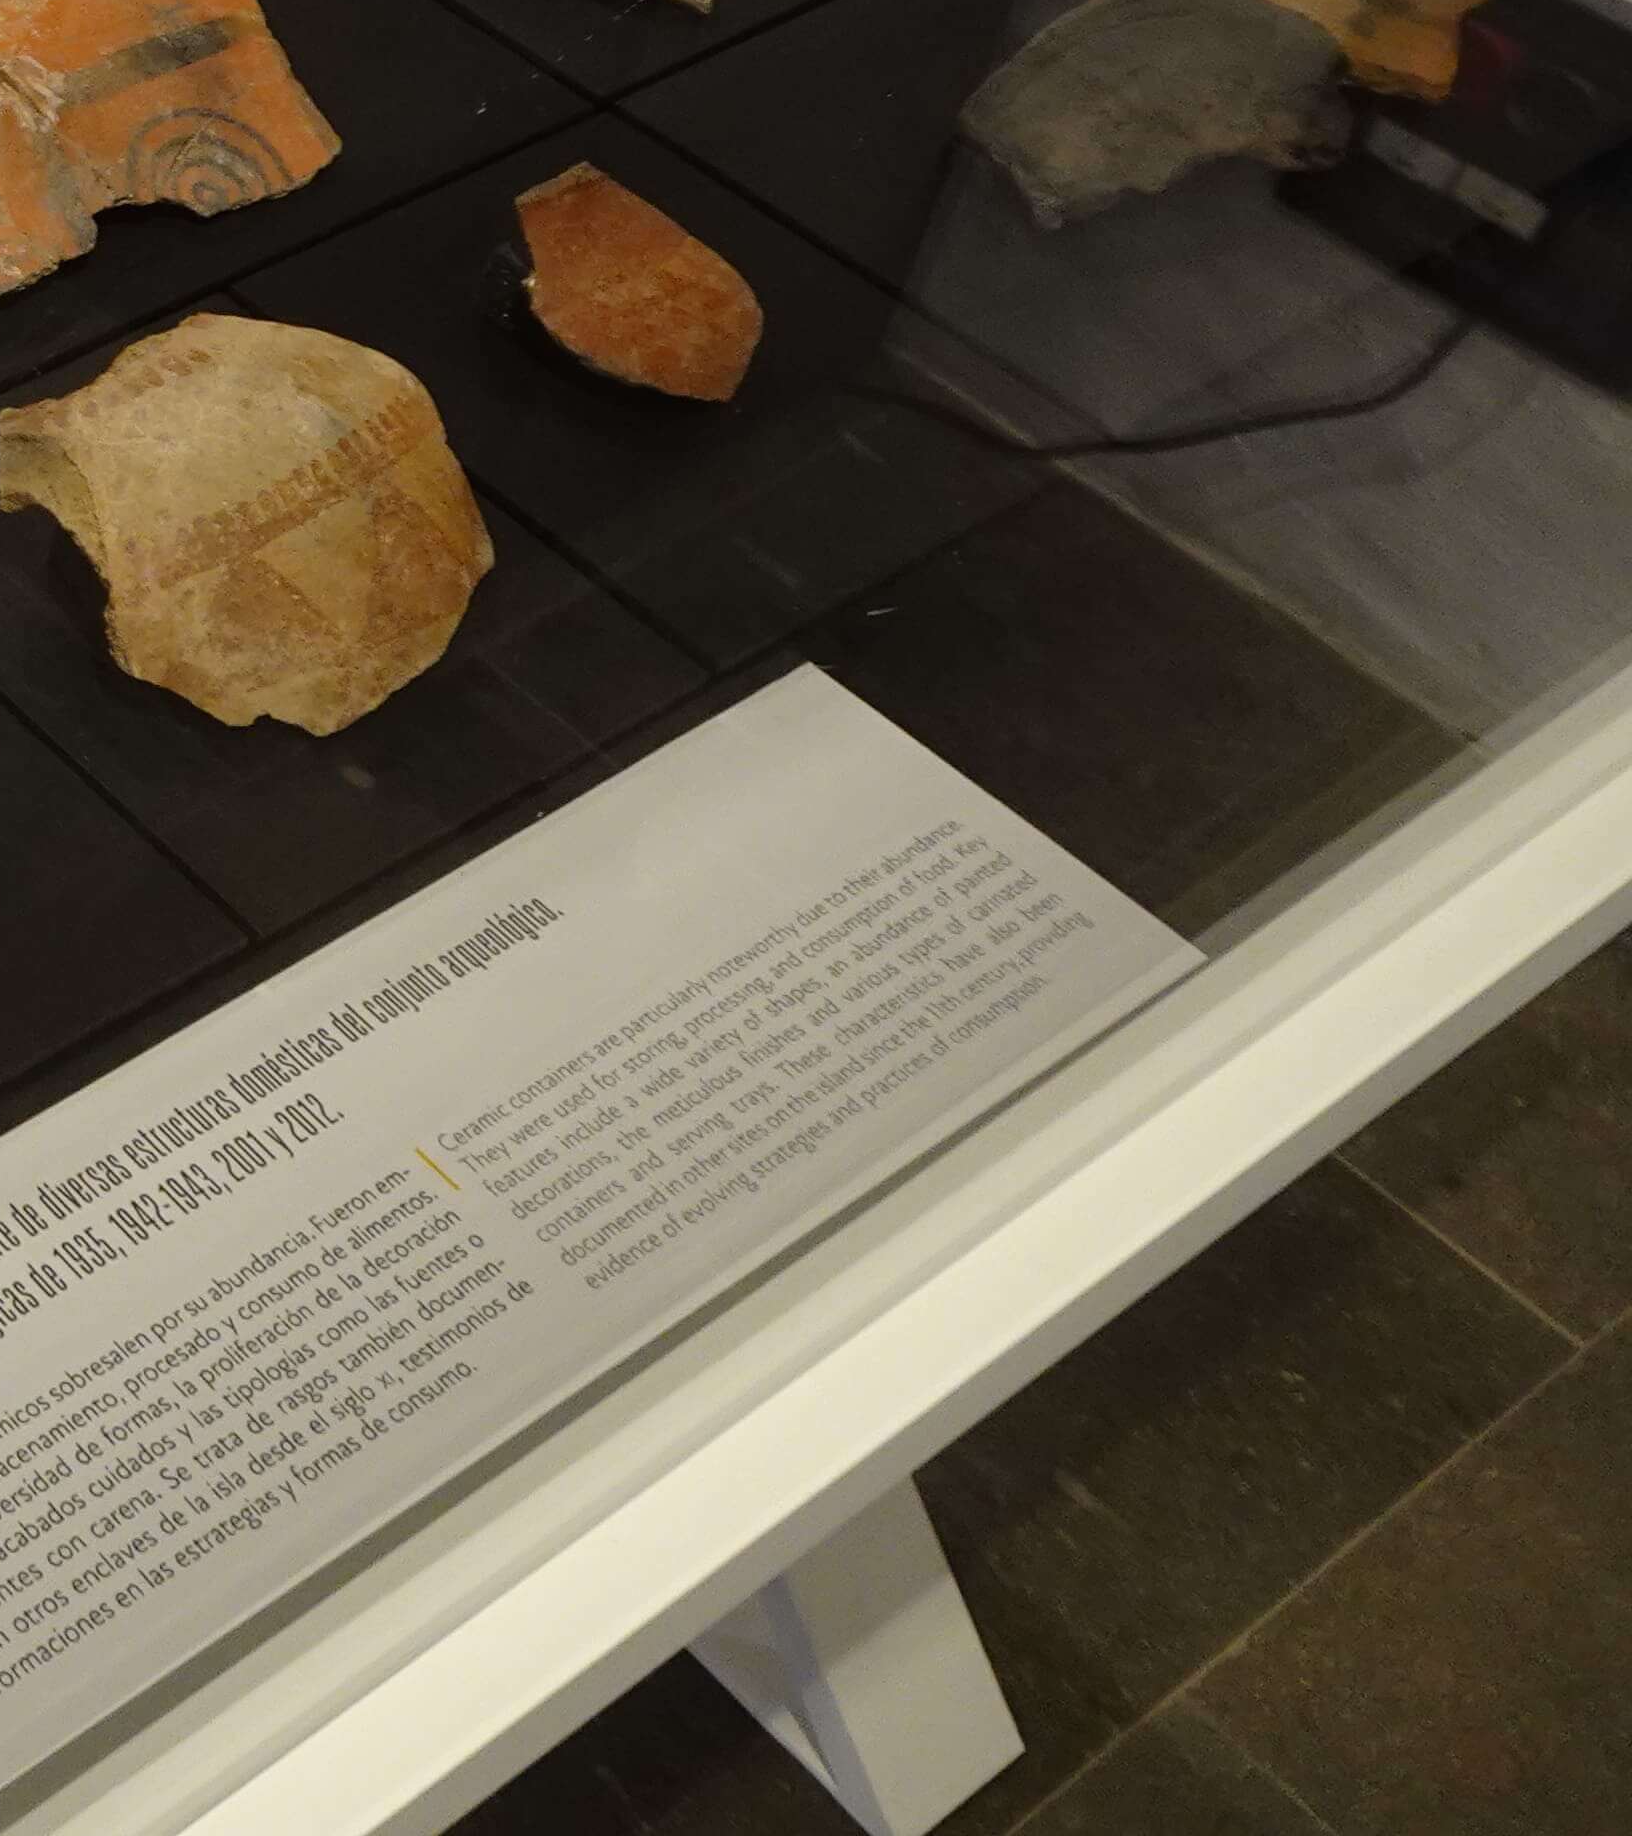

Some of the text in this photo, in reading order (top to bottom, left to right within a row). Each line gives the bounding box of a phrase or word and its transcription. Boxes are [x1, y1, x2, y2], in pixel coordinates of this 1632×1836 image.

[8, 1201, 50, 1238] de
[35, 1153, 134, 1221] diversas
[121, 1088, 242, 1171] estructuras
[225, 1027, 345, 1106] domésticas
[327, 1001, 376, 1044] del
[361, 962, 452, 1025] conjunto
[437, 897, 566, 979] arqueológico.
[272, 1092, 346, 1144] 2012.
[436, 922, 801, 1153] Ceramic containers are particularly noteworthy
[456, 1141, 512, 1174] They
[506, 1113, 555, 1146] were
[552, 1081, 597, 1119] used
[589, 1068, 622, 1091] for
[768, 950, 805, 980] and
[800, 892, 901, 959] consumption
[480, 1147, 560, 1198] features
[559, 1105, 625, 1151] include
[622, 1095, 641, 1110] a
[639, 1066, 686, 1098] wide
[683, 1027, 745, 1069] variety
[742, 1008, 764, 1032] of
[615, 1125, 652, 1151] the
[651, 1065, 744, 1128] meticulous
[806, 996, 842, 1028] and
[107, 1162, 234, 1247] 1942-1943,
[209, 1129, 278, 1183] 2001
[262, 1126, 296, 1160] y
[534, 1179, 628, 1244] containers
[627, 1147, 666, 1183] and
[665, 1111, 736, 1157] serving
[772, 1043, 833, 1080] These
[559, 1054, 867, 1267] documented in other sites on the island
[583, 1120, 833, 1291] evidence of evolving strategies
[25, 1261, 69, 1300] de
[47, 1332, 153, 1403] sobresalen
[149, 1308, 185, 1345] por
[182, 1295, 210, 1318] su
[206, 1230, 317, 1303] abundancia.
[307, 1189, 378, 1235] Fueron
[374, 1169, 411, 1195] em-
[51, 1225, 129, 1281] 1935,
[74, 1441, 105, 1466] de
[99, 1396, 182, 1447] formas,
[171, 1380, 199, 1399] la
[197, 1304, 316, 1391] proliferación
[314, 1286, 344, 1310] de
[336, 1273, 364, 1292] la
[362, 1210, 463, 1278] decoración
[122, 1326, 222, 1401] procesado
[219, 1315, 239, 1336] y
[236, 1262, 322, 1321] consumo
[320, 1245, 349, 1268] de
[346, 1190, 440, 1251] alimentos.
[11, 1589, 71, 1634] otros
[70, 1530, 159, 1595] enclaves
[158, 1510, 189, 1536] de
[182, 1495, 212, 1515] la
[205, 1471, 247, 1501] isla
[247, 1430, 309, 1476] desde
[308, 1409, 331, 1435] el
[329, 1385, 377, 1422] siglo
[397, 1298, 509, 1373] testimonios
[505, 1280, 535, 1303] de
[45, 1534, 88, 1568] con
[89, 1489, 164, 1540] carena.
[158, 1466, 193, 1491] Se
[191, 1431, 245, 1470] trata
[245, 1411, 276, 1435] de
[275, 1368, 339, 1415] rasgos
[336, 1317, 417, 1374] también
[416, 1259, 506, 1322] documen-
[87, 1434, 178, 1499] cuidados
[175, 1422, 195, 1445] y
[188, 1403, 225, 1429] las
[221, 1343, 317, 1410] tipologías
[315, 1308, 370, 1349] como
[363, 1288, 400, 1313] las
[392, 1243, 470, 1294] fuentes
[466, 1233, 486, 1249] o
[114, 1582, 145, 1609] en
[136, 1561, 176, 1589] las
[173, 1490, 282, 1569] estrategias
[277, 1480, 298, 1504] y
[288, 1436, 363, 1487] formas
[359, 1417, 390, 1442] de
[387, 1361, 479, 1424] consumo.
